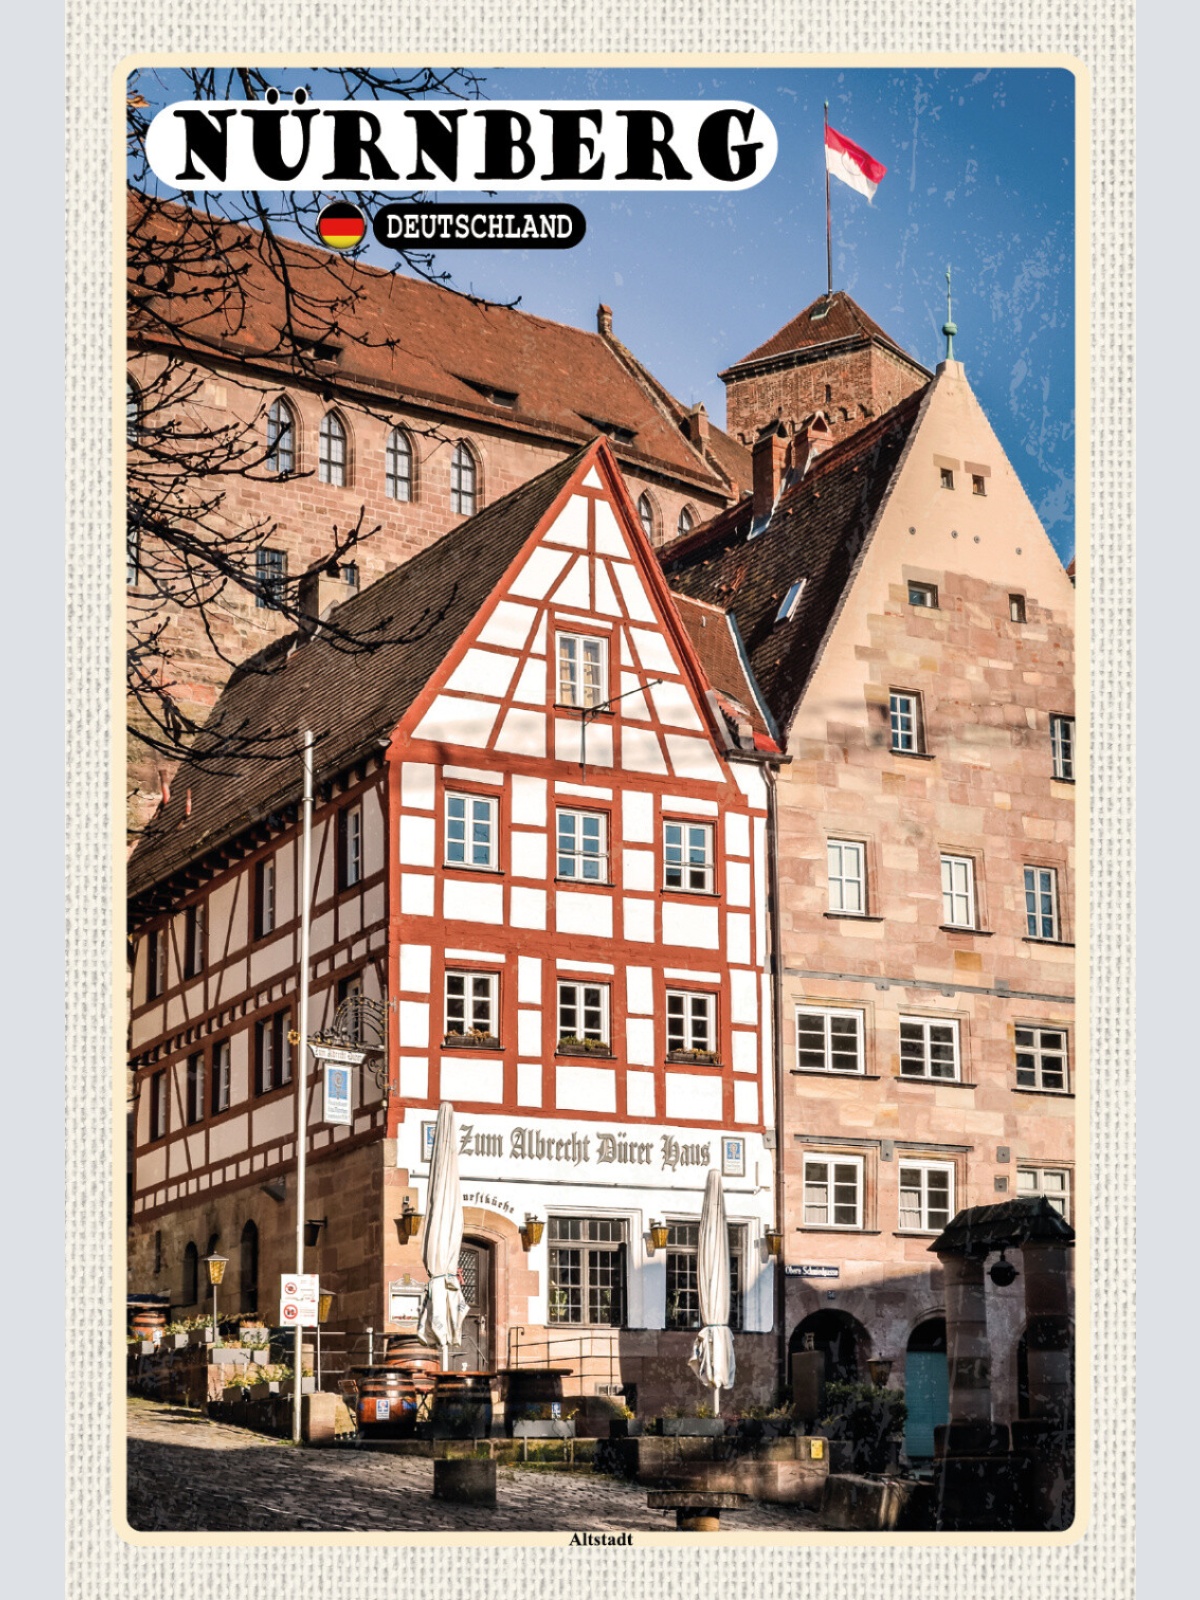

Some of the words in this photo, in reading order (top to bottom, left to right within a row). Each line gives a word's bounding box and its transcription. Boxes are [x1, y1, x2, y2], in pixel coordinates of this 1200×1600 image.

[459, 1124, 503, 1158] Zum
[509, 1126, 591, 1167] Albrecht
[596, 1131, 654, 1165] Dürer
[660, 1134, 711, 1173] Haus
